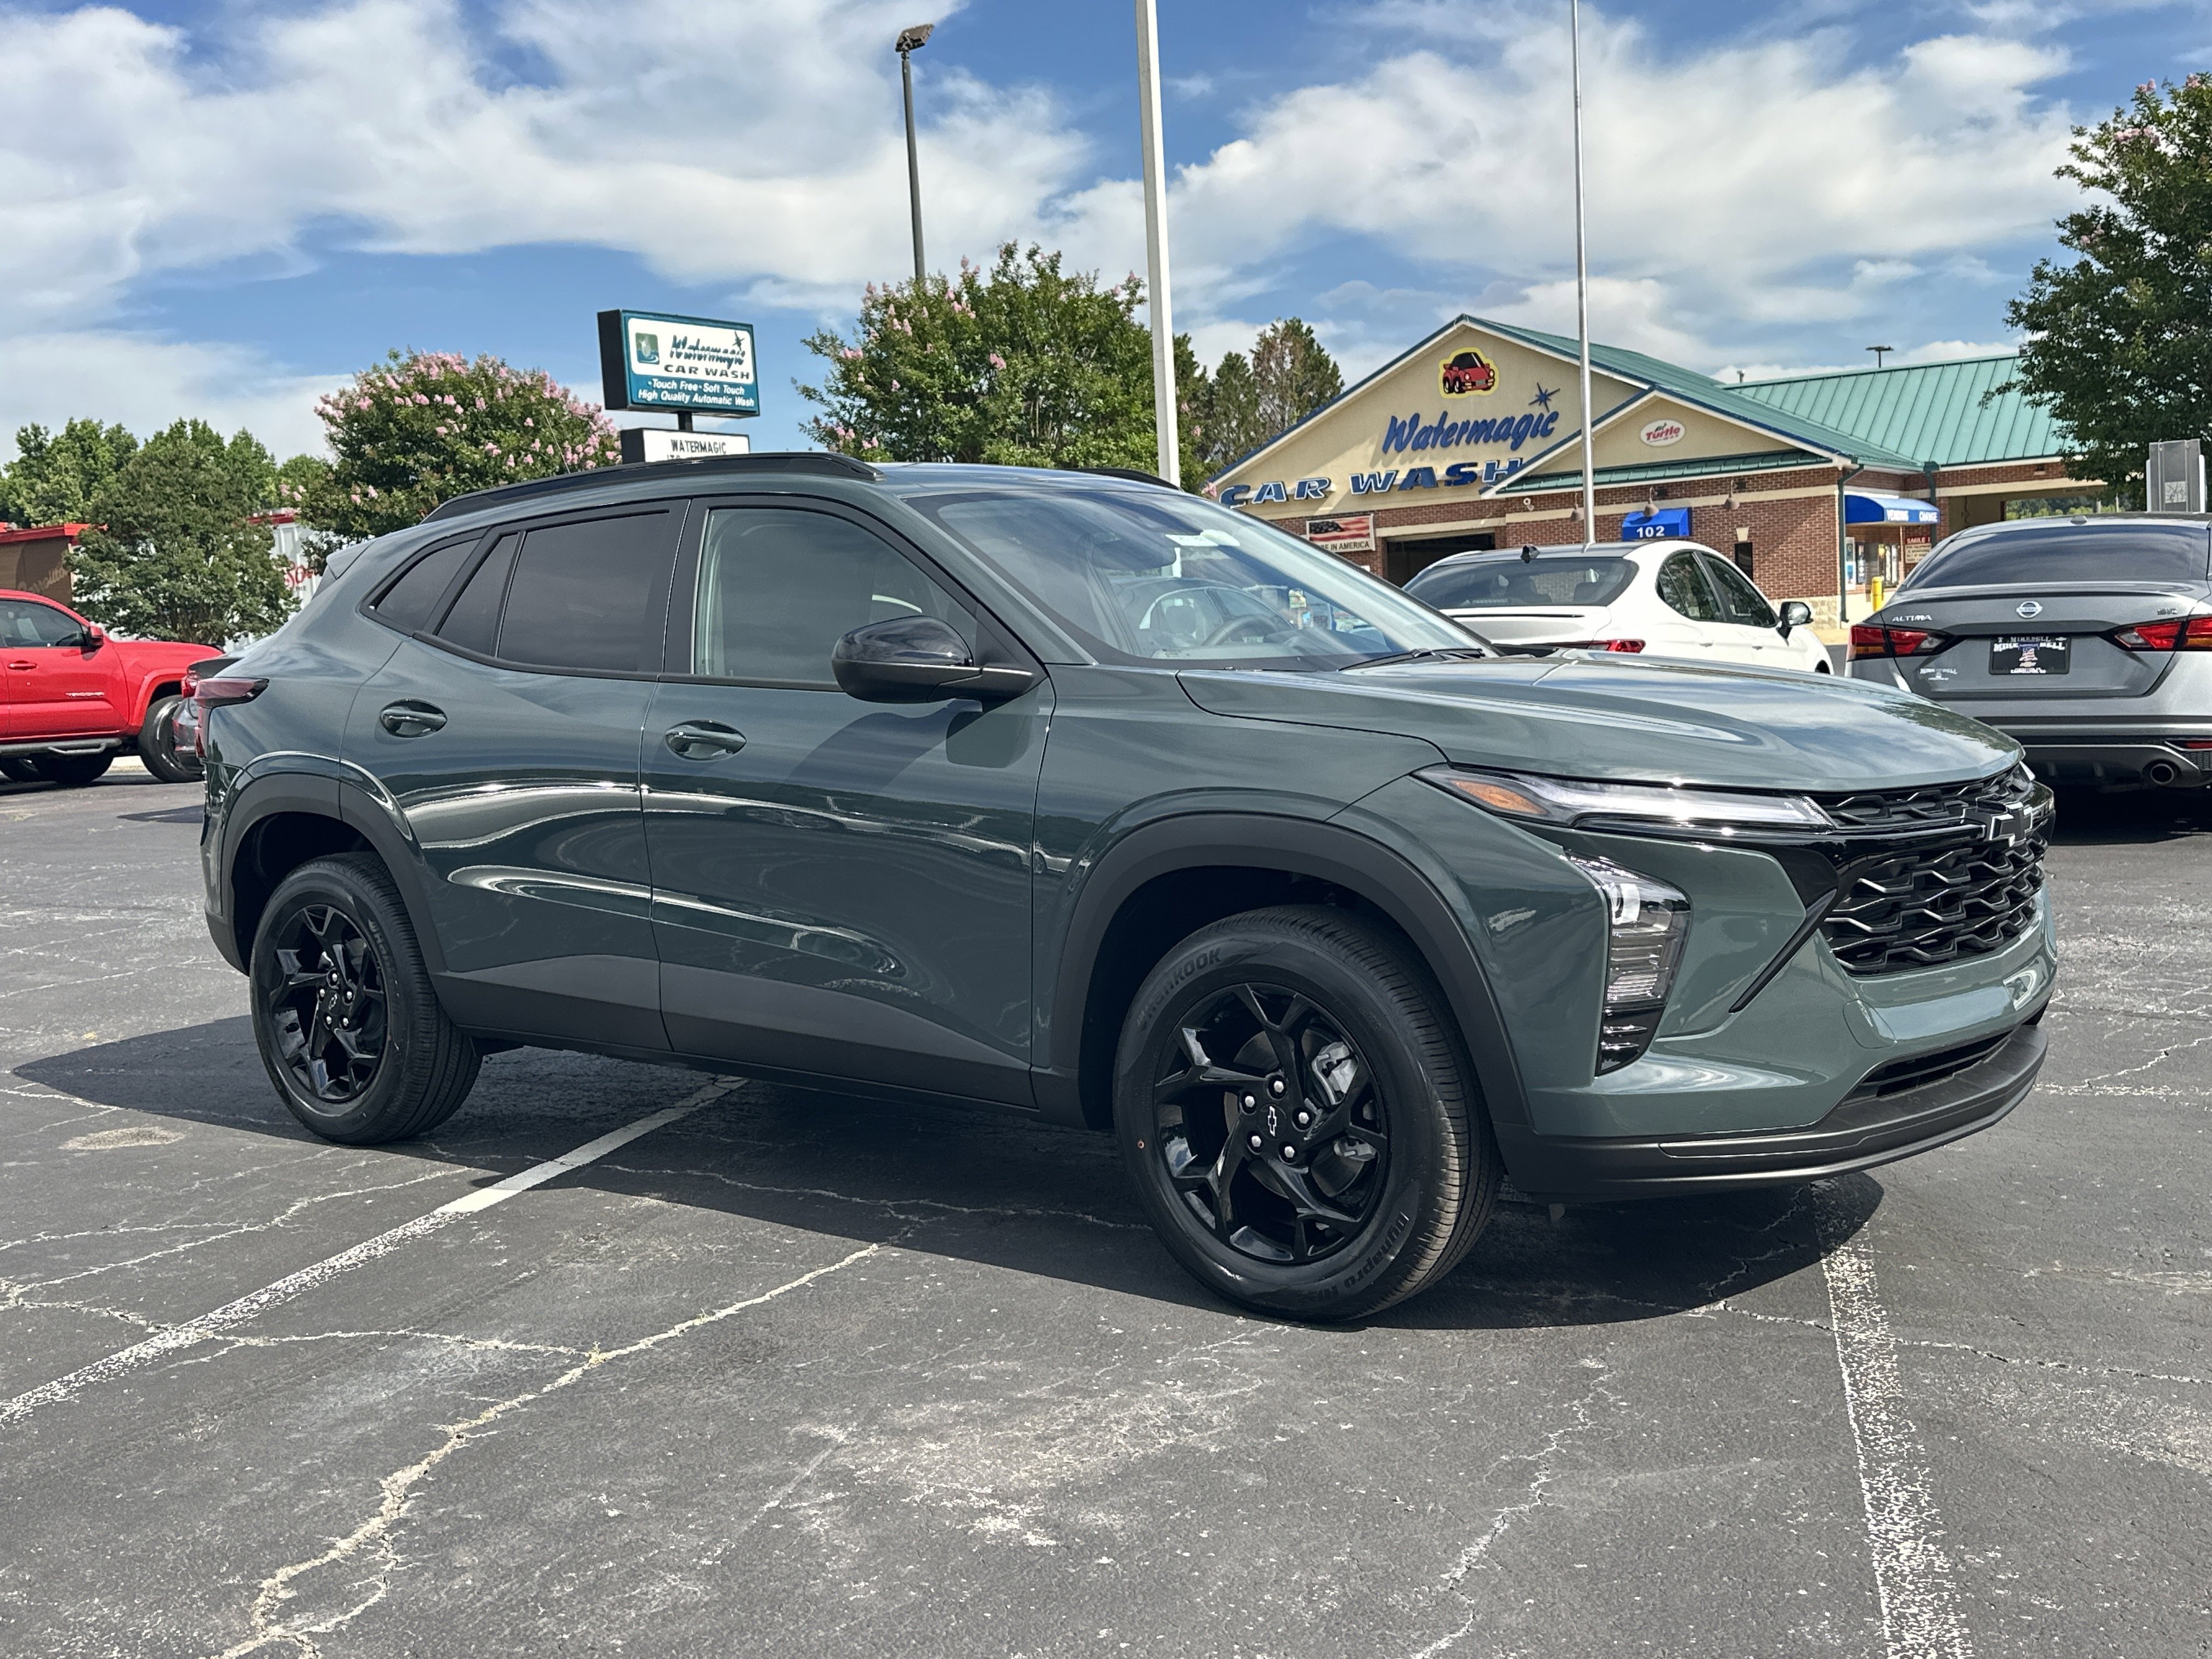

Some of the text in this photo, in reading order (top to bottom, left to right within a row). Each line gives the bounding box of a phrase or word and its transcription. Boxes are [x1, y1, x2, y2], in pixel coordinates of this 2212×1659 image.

[664, 364, 749, 379] CAR WASH
[652, 379, 676, 390] Touch
[703, 383, 720, 393] Soft
[723, 385, 744, 395] Touch
[638, 390, 754, 407] High Quality Automatic Wash
[1382, 411, 1559, 454] Watermagic
[1646, 426, 1680, 441] Turtle
[670, 439, 727, 455] WATERMAGIC
[1219, 458, 1523, 509] CAR WASH
[1637, 526, 1664, 538] 102
[1339, 541, 1369, 550] AMERICA
